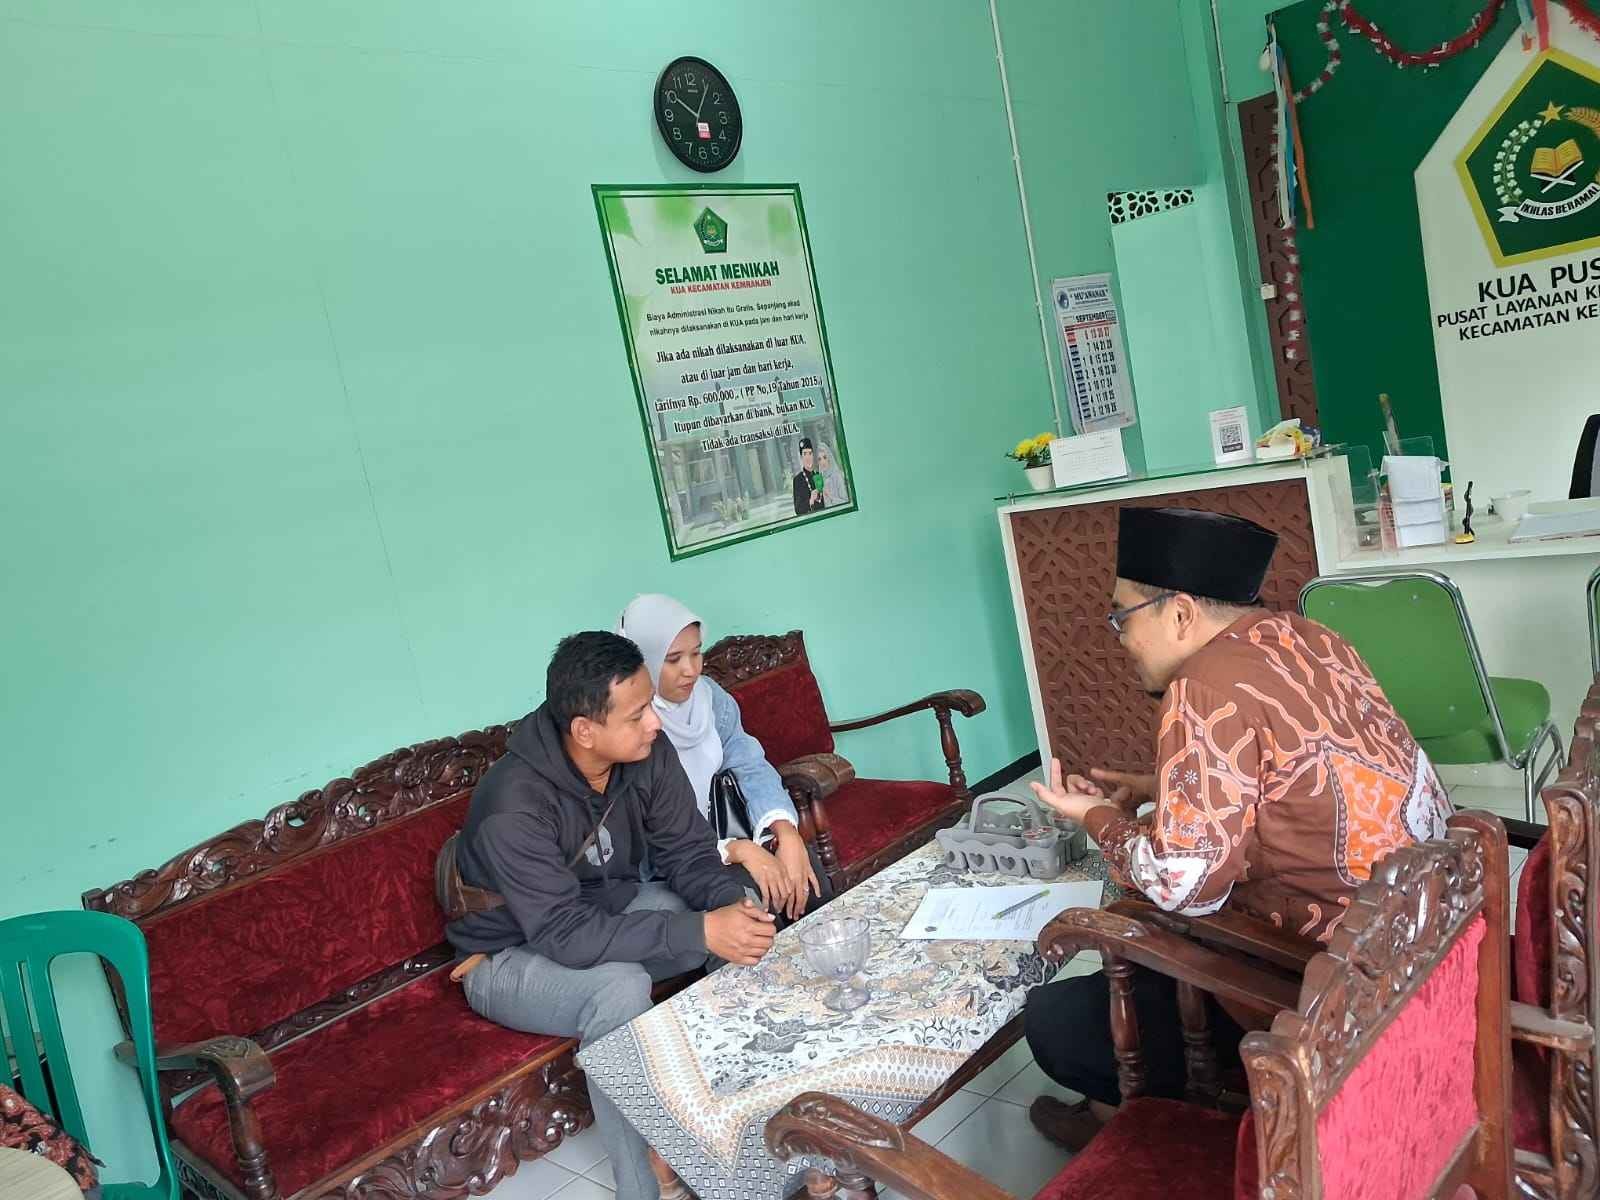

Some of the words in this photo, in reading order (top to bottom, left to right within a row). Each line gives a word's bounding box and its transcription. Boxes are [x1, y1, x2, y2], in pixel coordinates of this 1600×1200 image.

[673, 75, 682, 89] 11
[685, 73, 697, 86] 12
[713, 92, 721, 105] 2
[665, 109, 674, 122] 9
[719, 111, 728, 125] 3
[673, 127, 682, 140] 8
[719, 129, 727, 140] 4
[685, 141, 693, 156] 7
[699, 146, 708, 160] 6
[711, 142, 720, 156] 5
[1520, 203, 1554, 216] IKHLAS
[1556, 185, 1600, 214] BERAMAL
[656, 264, 718, 285] SELAMAT
[720, 260, 780, 279] MENIKAH
[671, 286, 687, 295] KUA
[687, 282, 730, 293] KECAMATAN
[731, 278, 772, 290] KEMRANJEN
[1478, 273, 1537, 302] KUA
[647, 313, 666, 323] Biaya
[667, 307, 707, 319] Administrasi
[707, 305, 726, 315] Nikah
[727, 305, 735, 313] Itu
[756, 301, 787, 311] Sepanjang
[1437, 306, 1488, 328] PUSAT
[1496, 289, 1578, 317] LAYANAN
[1585, 284, 1600, 301] K
[649, 326, 680, 336] nikahnya
[681, 321, 722, 333] dilaksanakan
[722, 320, 729, 328] di
[729, 319, 743, 328] KUA
[744, 317, 759, 327] pada
[759, 316, 771, 326] jam
[771, 315, 783, 323] dan
[783, 313, 795, 321] hari
[795, 312, 809, 321] kerja
[1459, 309, 1570, 341] KECAMATAN
[1577, 303, 1598, 320] KE
[656, 350, 674, 363] Jika
[676, 348, 691, 361] ada
[692, 345, 715, 358] nikah
[716, 340, 765, 355] dilaksanakan
[766, 337, 774, 349] di
[774, 336, 788, 348] luar
[681, 372, 700, 384] atau
[701, 369, 709, 381] di
[710, 368, 725, 380] luar
[726, 365, 741, 380] jam
[742, 363, 757, 375] dan
[757, 361, 773, 373] hari
[655, 398, 687, 412] tarifnya
[687, 395, 702, 409] Rp.
[745, 385, 755, 397] PP
[778, 380, 800, 392] Tahun
[674, 420, 702, 433] Itupun
[703, 411, 744, 427] dibayarkan
[745, 409, 754, 420] di
[775, 401, 798, 415] bukan
[702, 436, 725, 451] Tidak
[725, 434, 739, 447] ada
[740, 427, 773, 443] transaksi
[774, 424, 783, 437] di
